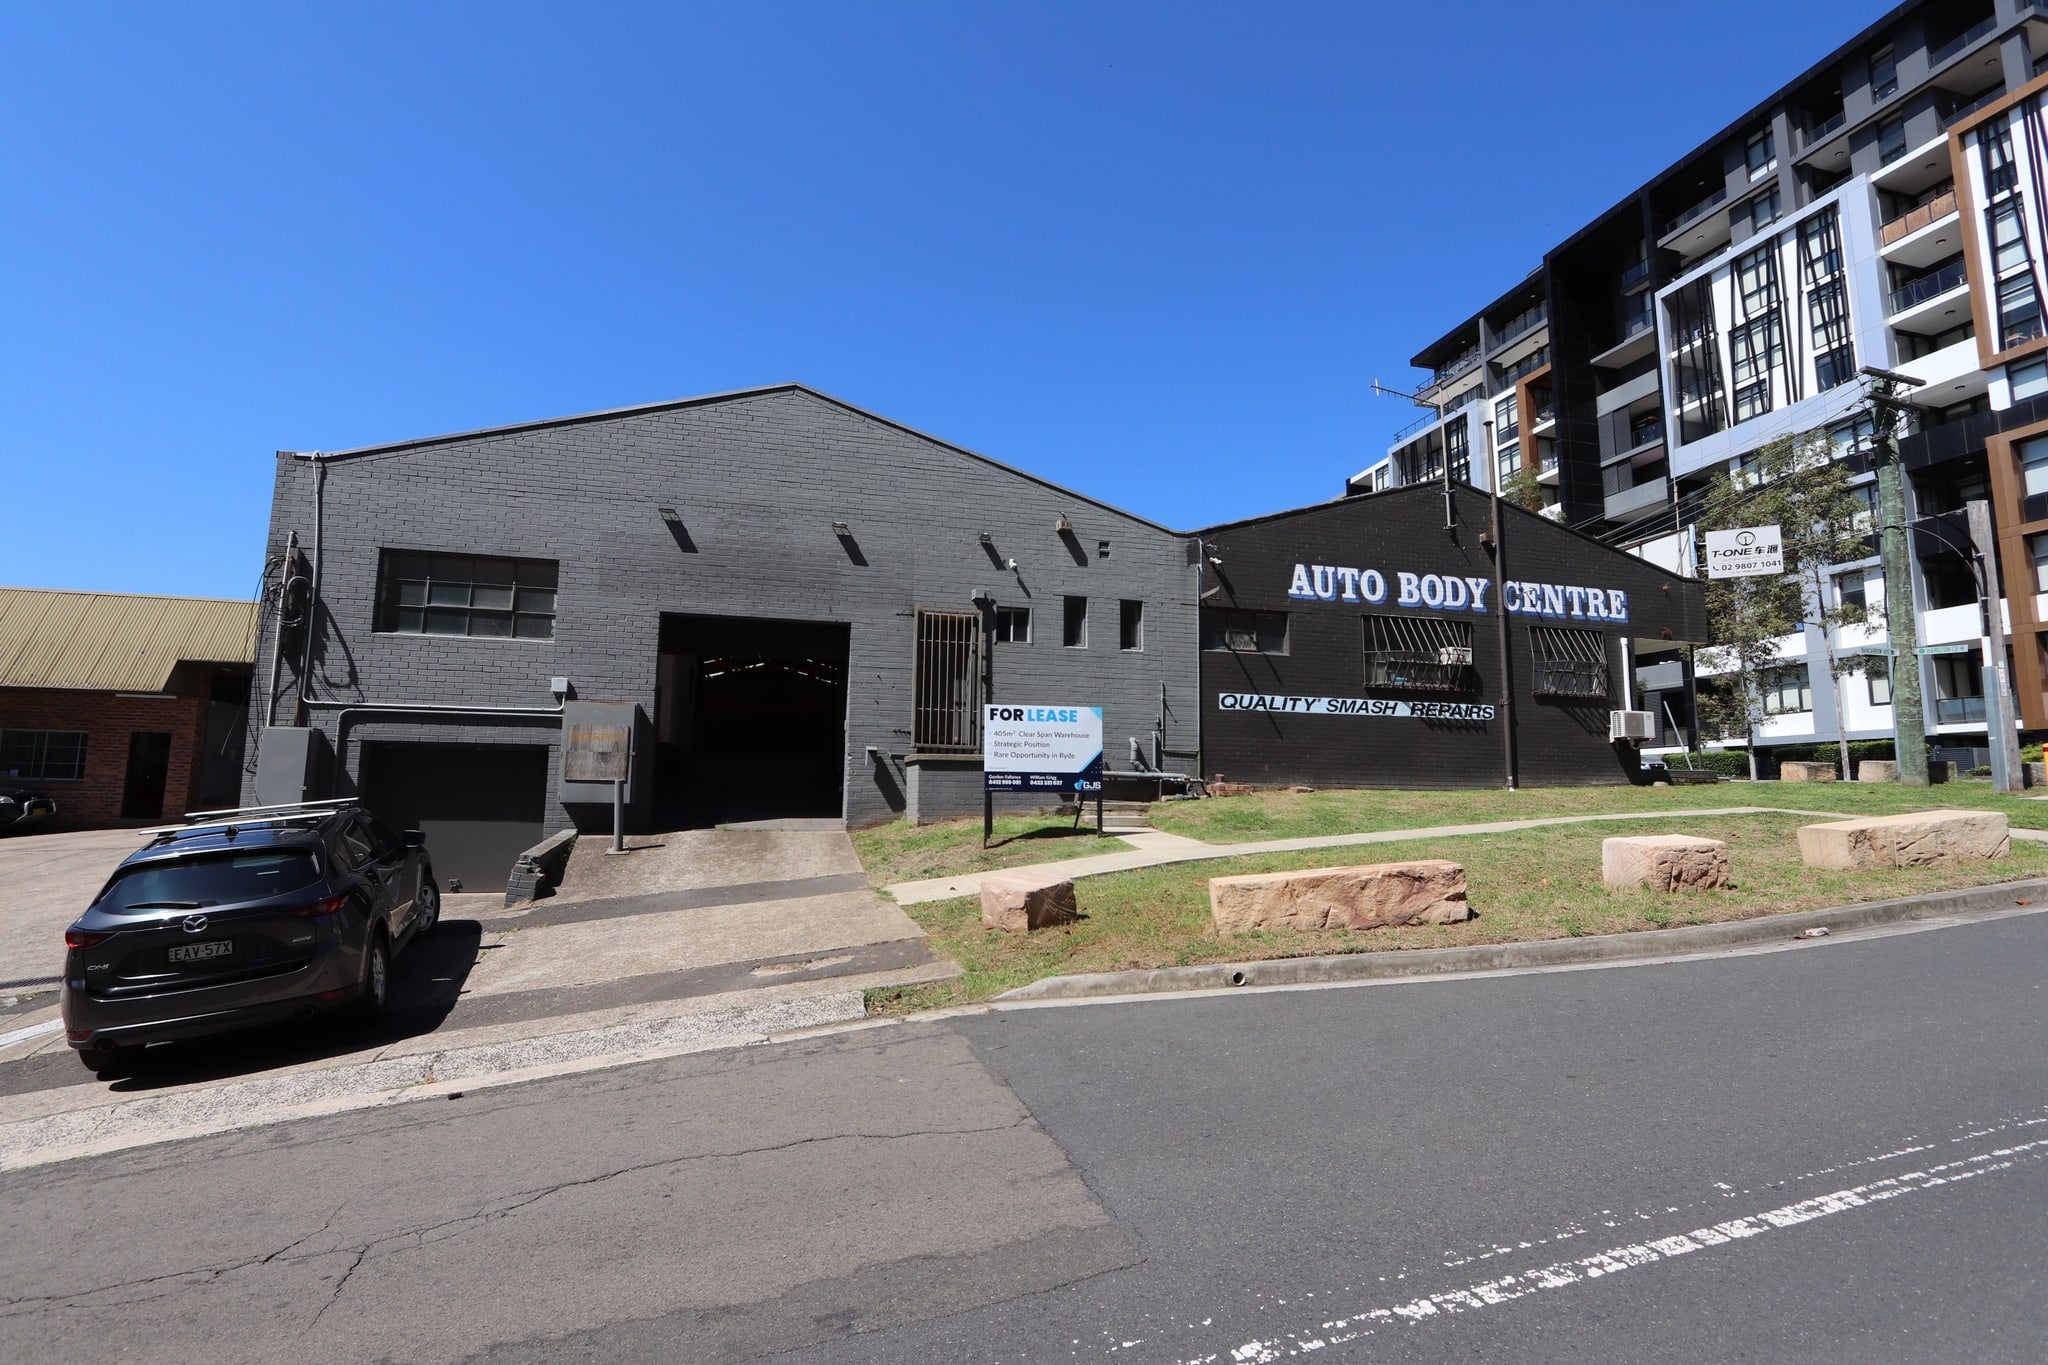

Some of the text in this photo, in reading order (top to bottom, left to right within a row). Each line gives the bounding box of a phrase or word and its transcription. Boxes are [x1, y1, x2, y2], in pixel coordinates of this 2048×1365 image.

[1712, 548, 1752, 558] T-ONE
[1735, 562, 1757, 570] 9807
[1760, 560, 1781, 568] 1041
[1288, 563, 1629, 624] AUTO BODY CENTRE
[1326, 698, 1397, 716] SMASH
[1410, 701, 1494, 721] REPAIRS
[989, 708, 1078, 723] FOR LEASE
[1037, 731, 1053, 740] Span
[993, 741, 1022, 749] Strategic
[1010, 752, 1051, 760] Opportunity
[1059, 752, 1075, 760] Ryde
[1083, 781, 1102, 789] GJS
